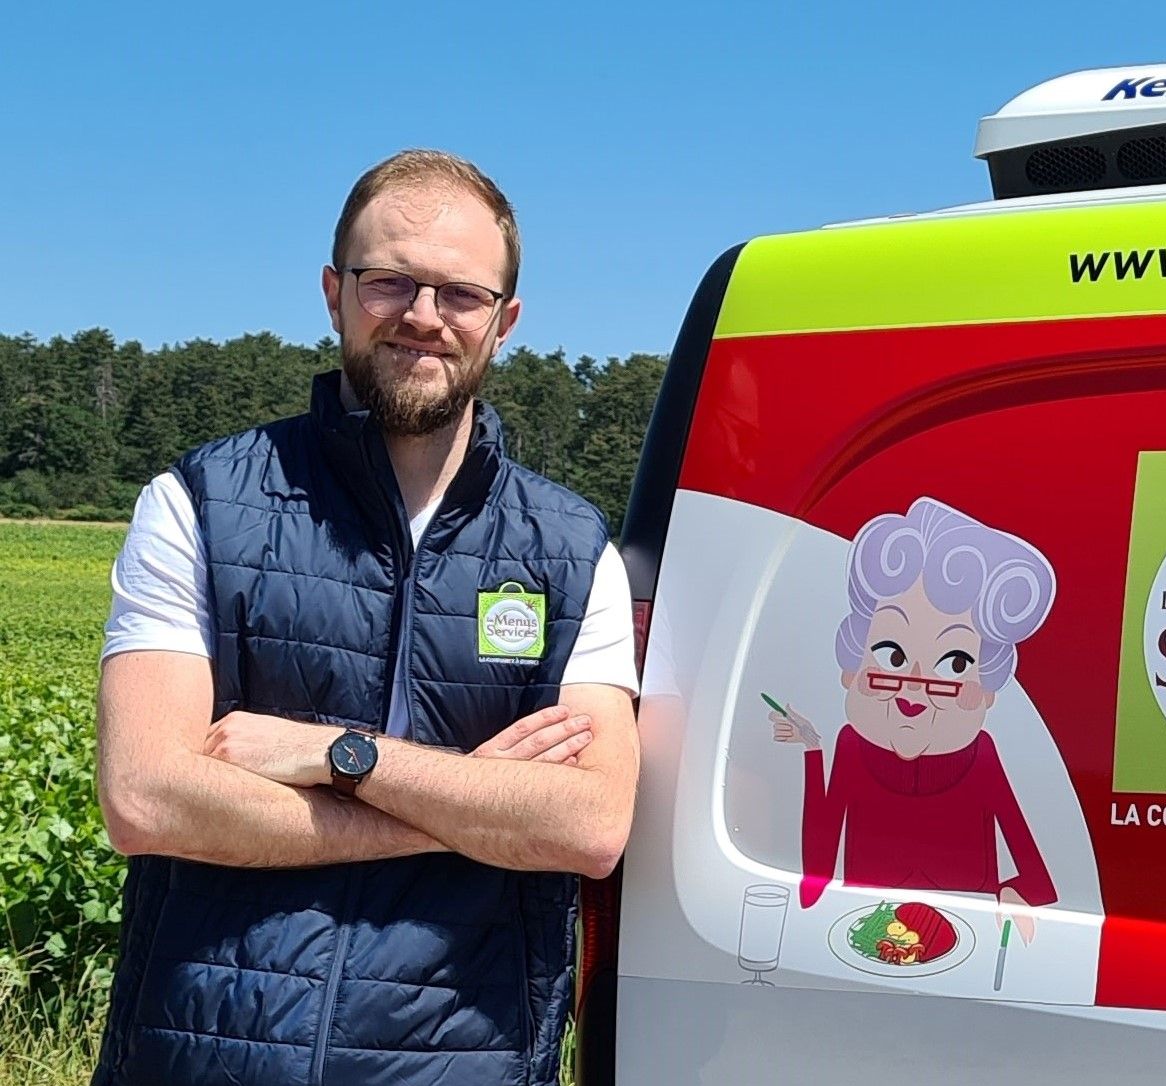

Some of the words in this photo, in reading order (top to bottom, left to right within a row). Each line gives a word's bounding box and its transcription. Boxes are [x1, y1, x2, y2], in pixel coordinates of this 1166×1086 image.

[495, 615, 537, 627] Menus
[487, 625, 537, 638] Services
[1111, 803, 1140, 826] LA
